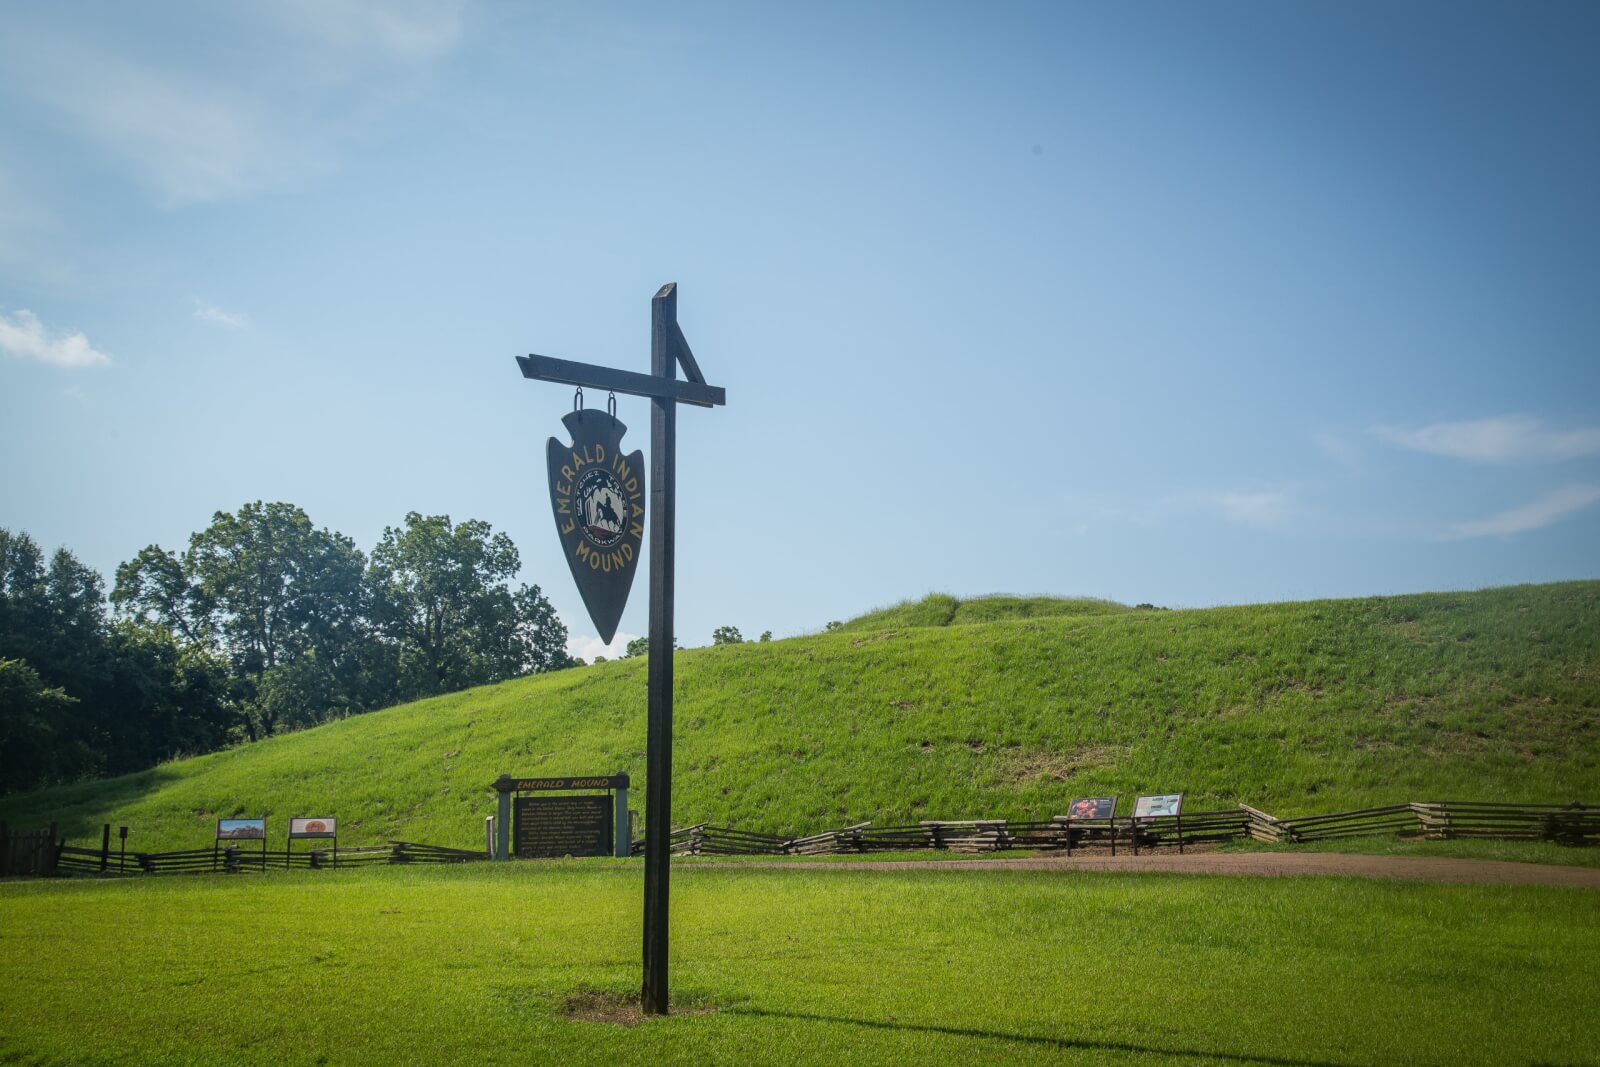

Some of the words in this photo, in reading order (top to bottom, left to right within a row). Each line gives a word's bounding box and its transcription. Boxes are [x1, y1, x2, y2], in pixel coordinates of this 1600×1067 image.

[557, 444, 605, 534] EMERALD
[613, 454, 644, 538] INDIAN
[576, 540, 633, 572] MOUND
[517, 779, 564, 789] EMERALD
[572, 778, 609, 788] MOUND
